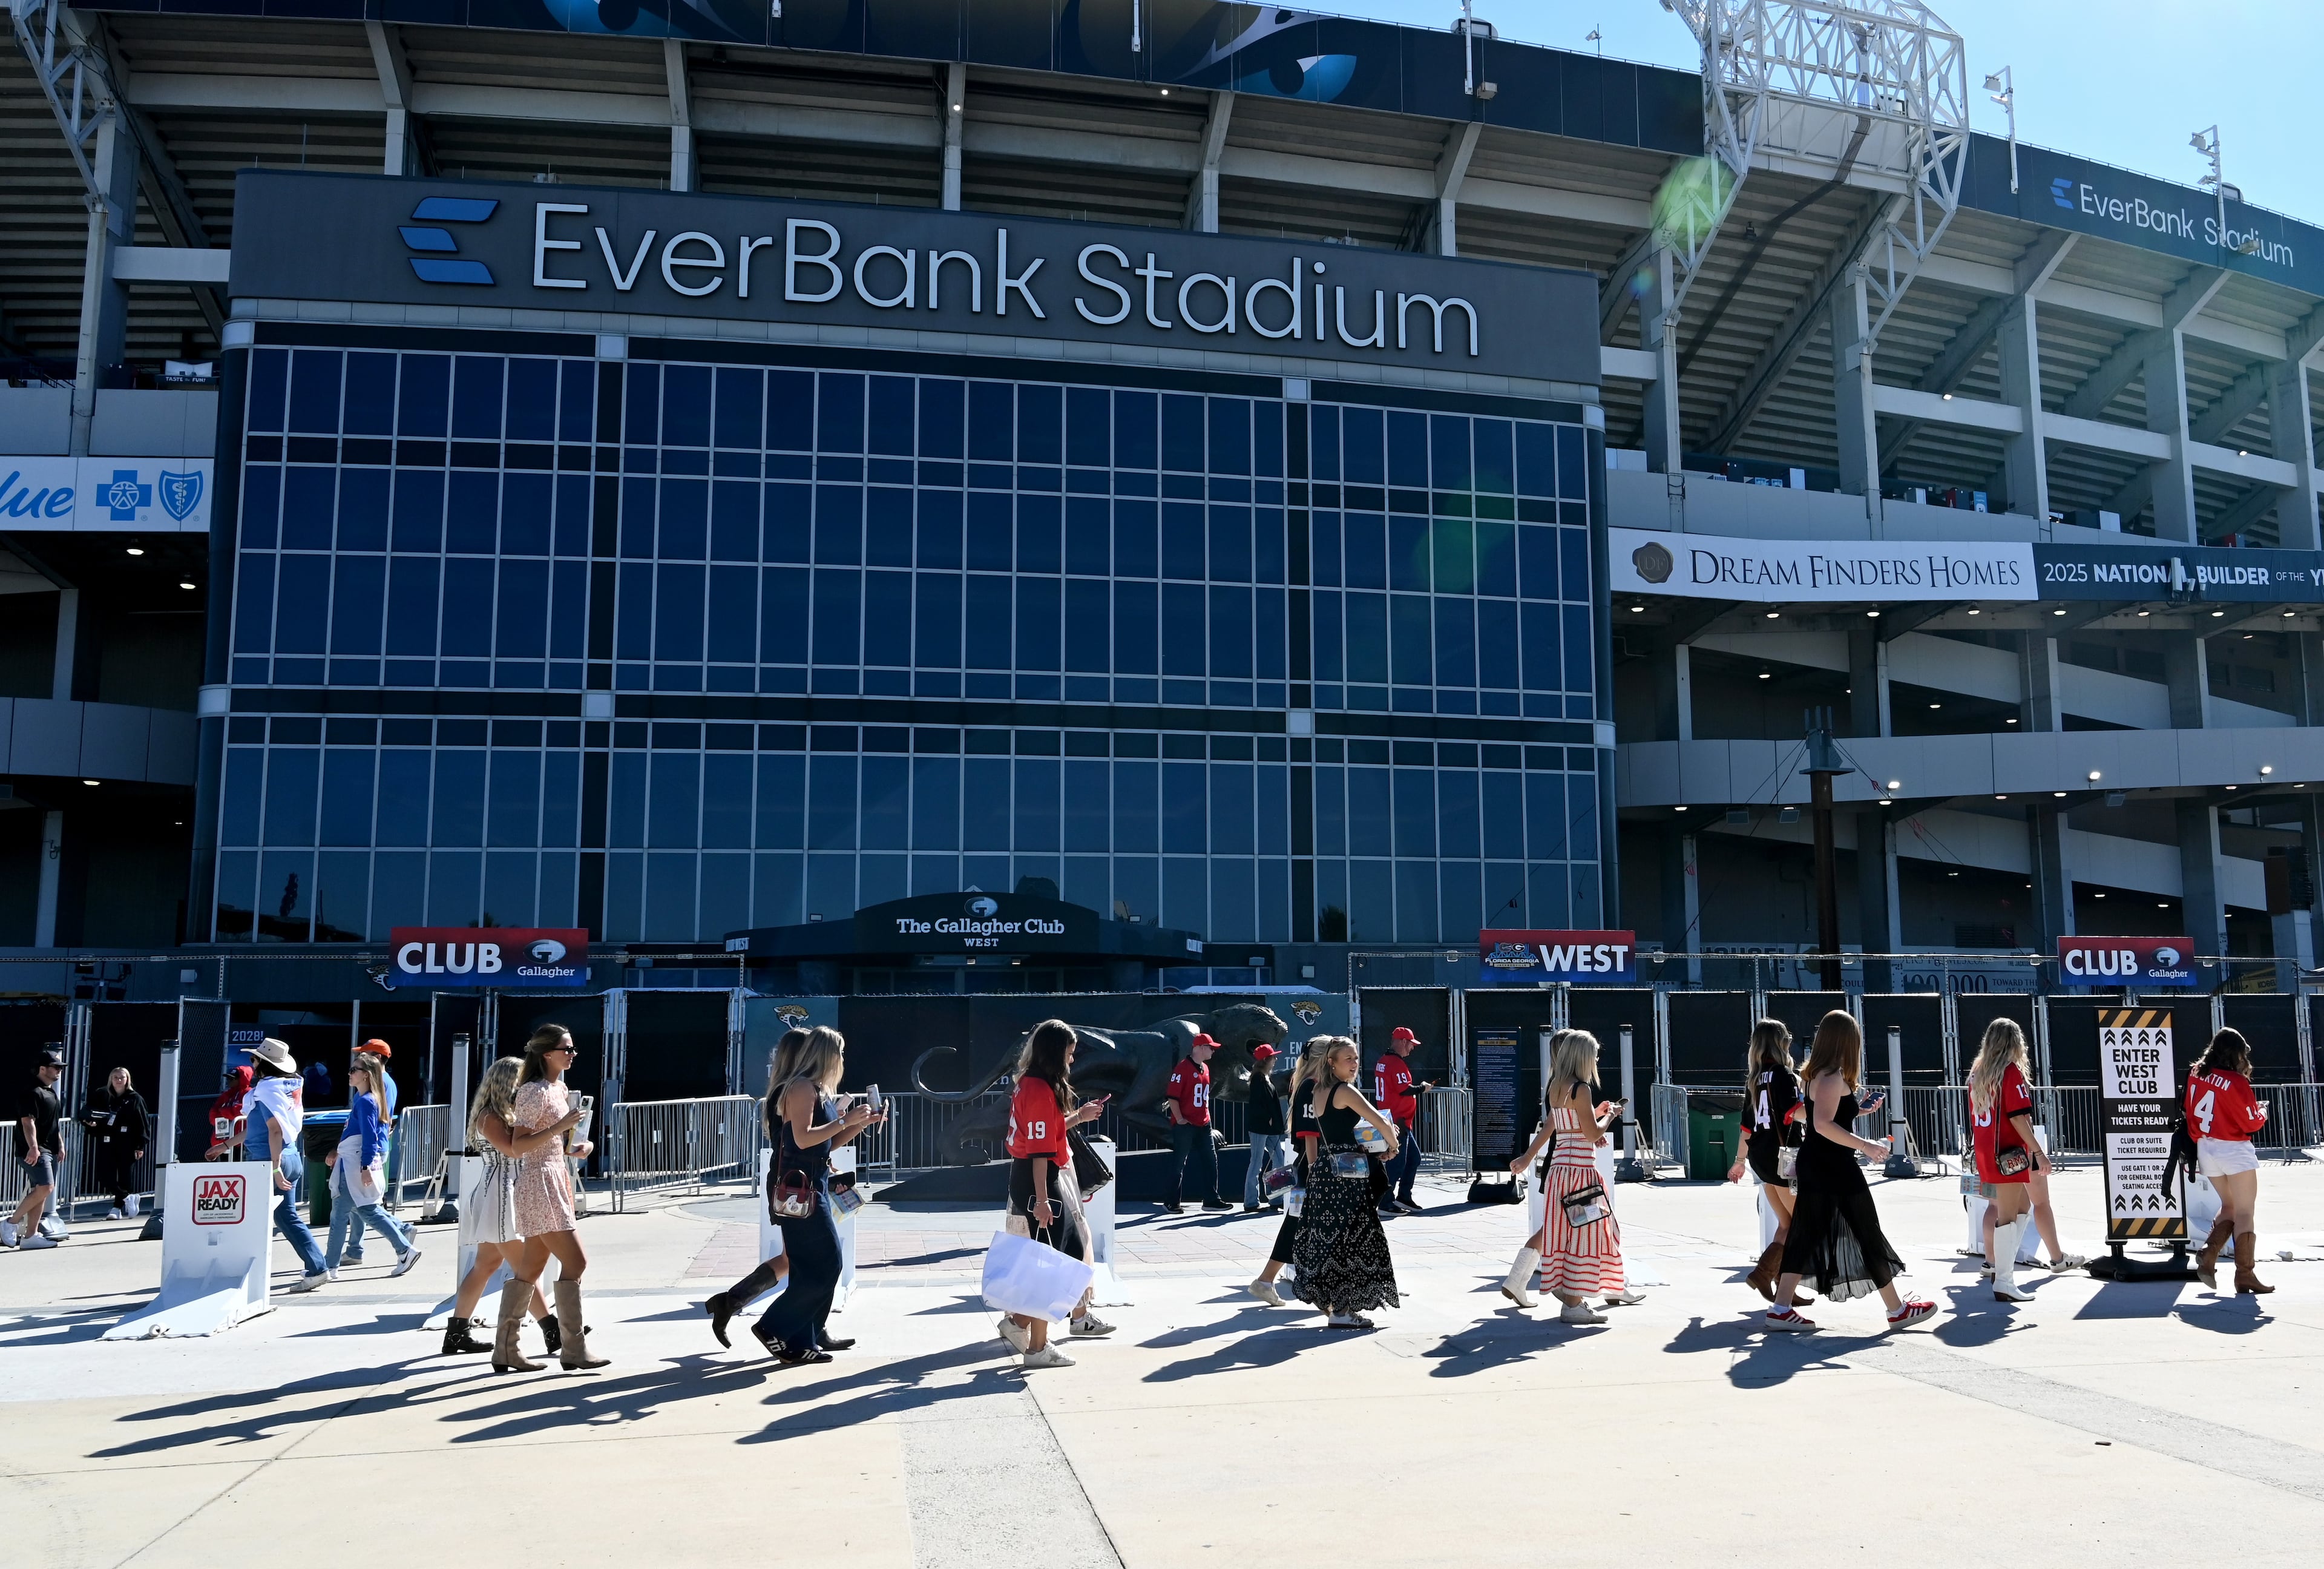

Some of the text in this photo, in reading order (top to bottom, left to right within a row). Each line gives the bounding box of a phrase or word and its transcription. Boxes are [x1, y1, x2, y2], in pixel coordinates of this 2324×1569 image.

[2079, 183, 2195, 240] EverBank
[533, 202, 1481, 357] EverBank Stadium
[1690, 549, 2020, 588] DREAM FINDERS HOMES
[2044, 563, 2087, 582] 2025
[2196, 565, 2270, 585] BUILDER
[2276, 571, 2287, 581] OF
[2288, 571, 2305, 581] THE
[896, 918, 1065, 936] The Gallagher Club
[964, 938, 999, 947] WEST
[397, 942, 502, 974] CLUB
[1539, 944, 1629, 973] WEST
[2065, 949, 2138, 976] CLUB
[517, 966, 576, 978] Gallagher
[2148, 969, 2188, 979] Gallagher
[232, 1031, 263, 1041] 2028!
[2112, 1049, 2160, 1062] ENTER
[1170, 1073, 1181, 1084] 84
[1396, 1073, 1408, 1084] 19
[2115, 1065, 2158, 1078] WEST
[2118, 1081, 2158, 1094] CLUB
[1193, 1084, 1210, 1107] 84
[1302, 1104, 1315, 1119] 19
[2111, 1117, 2142, 1125] TICKETS
[1027, 1121, 1046, 1139] 19
[199, 1180, 240, 1199] JAX
[197, 1198, 240, 1211] READY
